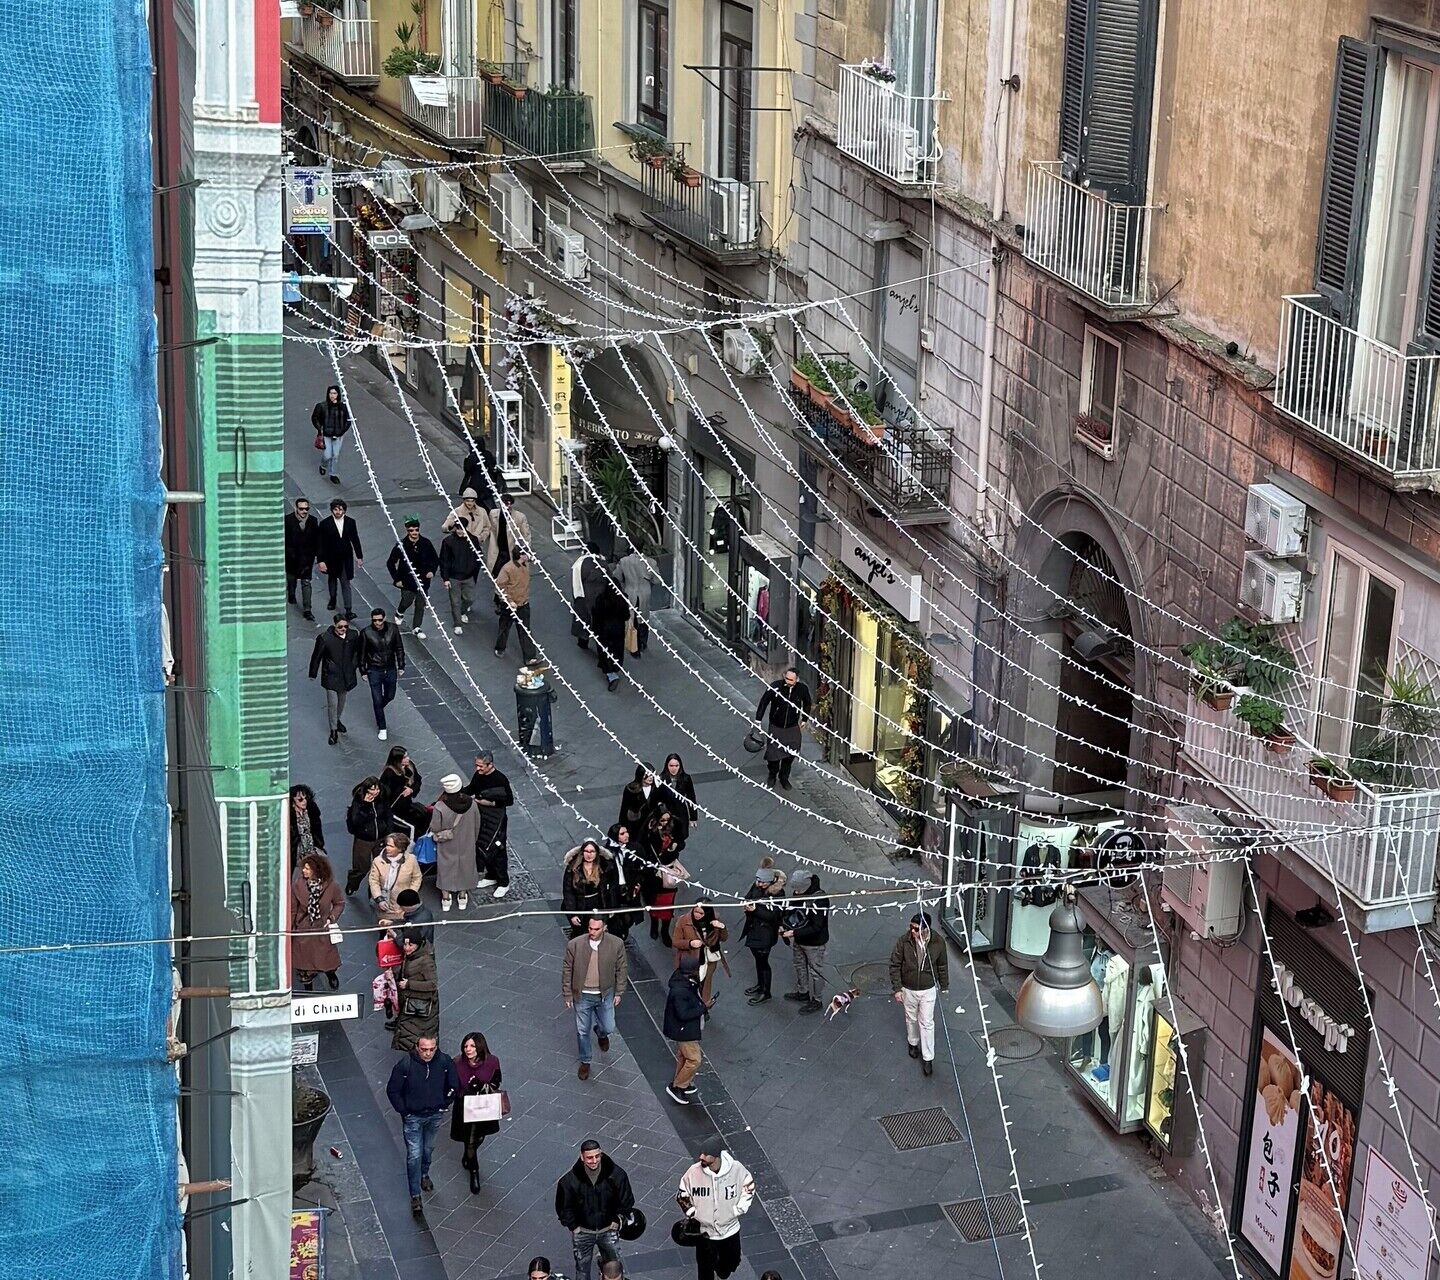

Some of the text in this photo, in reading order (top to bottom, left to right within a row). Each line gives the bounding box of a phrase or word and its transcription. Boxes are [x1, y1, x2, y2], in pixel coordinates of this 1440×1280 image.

[371, 235, 410, 246] IQOS
[294, 1003, 352, 1016] di Chiaia
